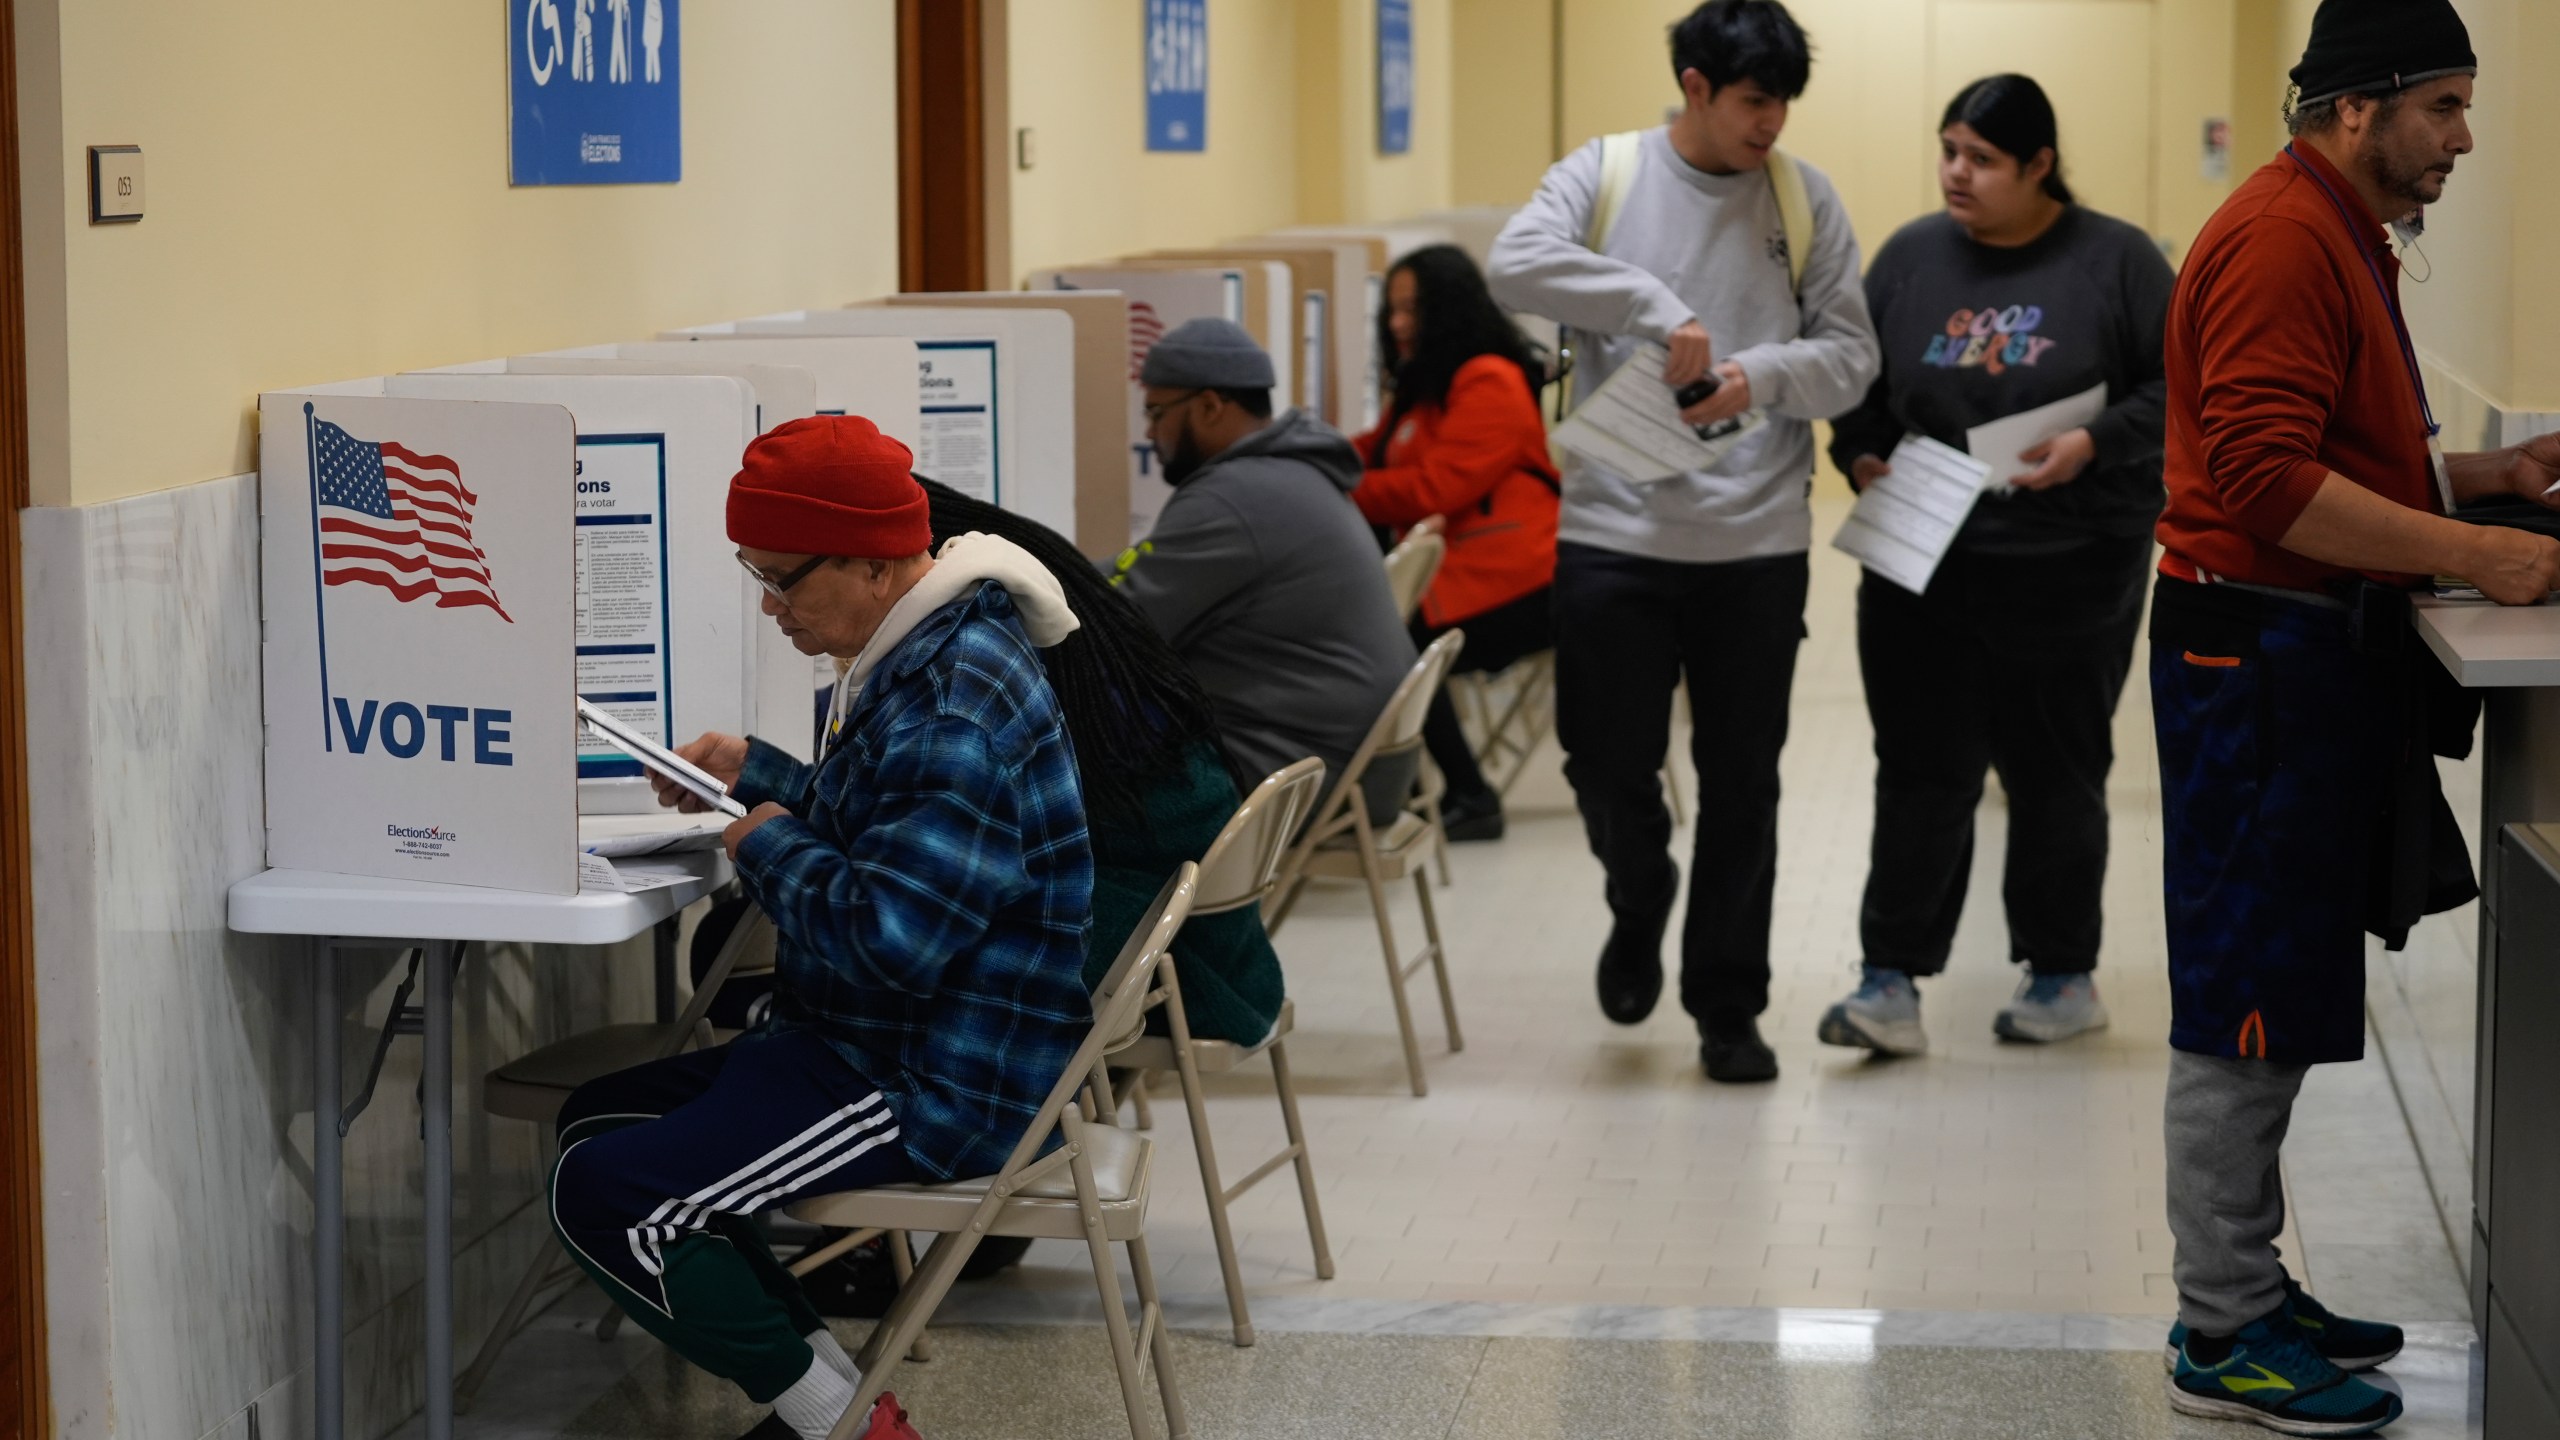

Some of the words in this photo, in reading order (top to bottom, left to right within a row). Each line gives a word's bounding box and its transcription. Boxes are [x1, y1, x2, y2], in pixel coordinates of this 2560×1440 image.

[588, 145, 621, 162] ELECTIONS
[117, 175, 131, 197] 053
[1945, 304, 2043, 337] GOOD
[1920, 331, 2057, 376] ENERGY
[590, 499, 616, 508] votar
[333, 697, 513, 766] VOTE
[395, 848, 450, 857] www.electionsource.com
